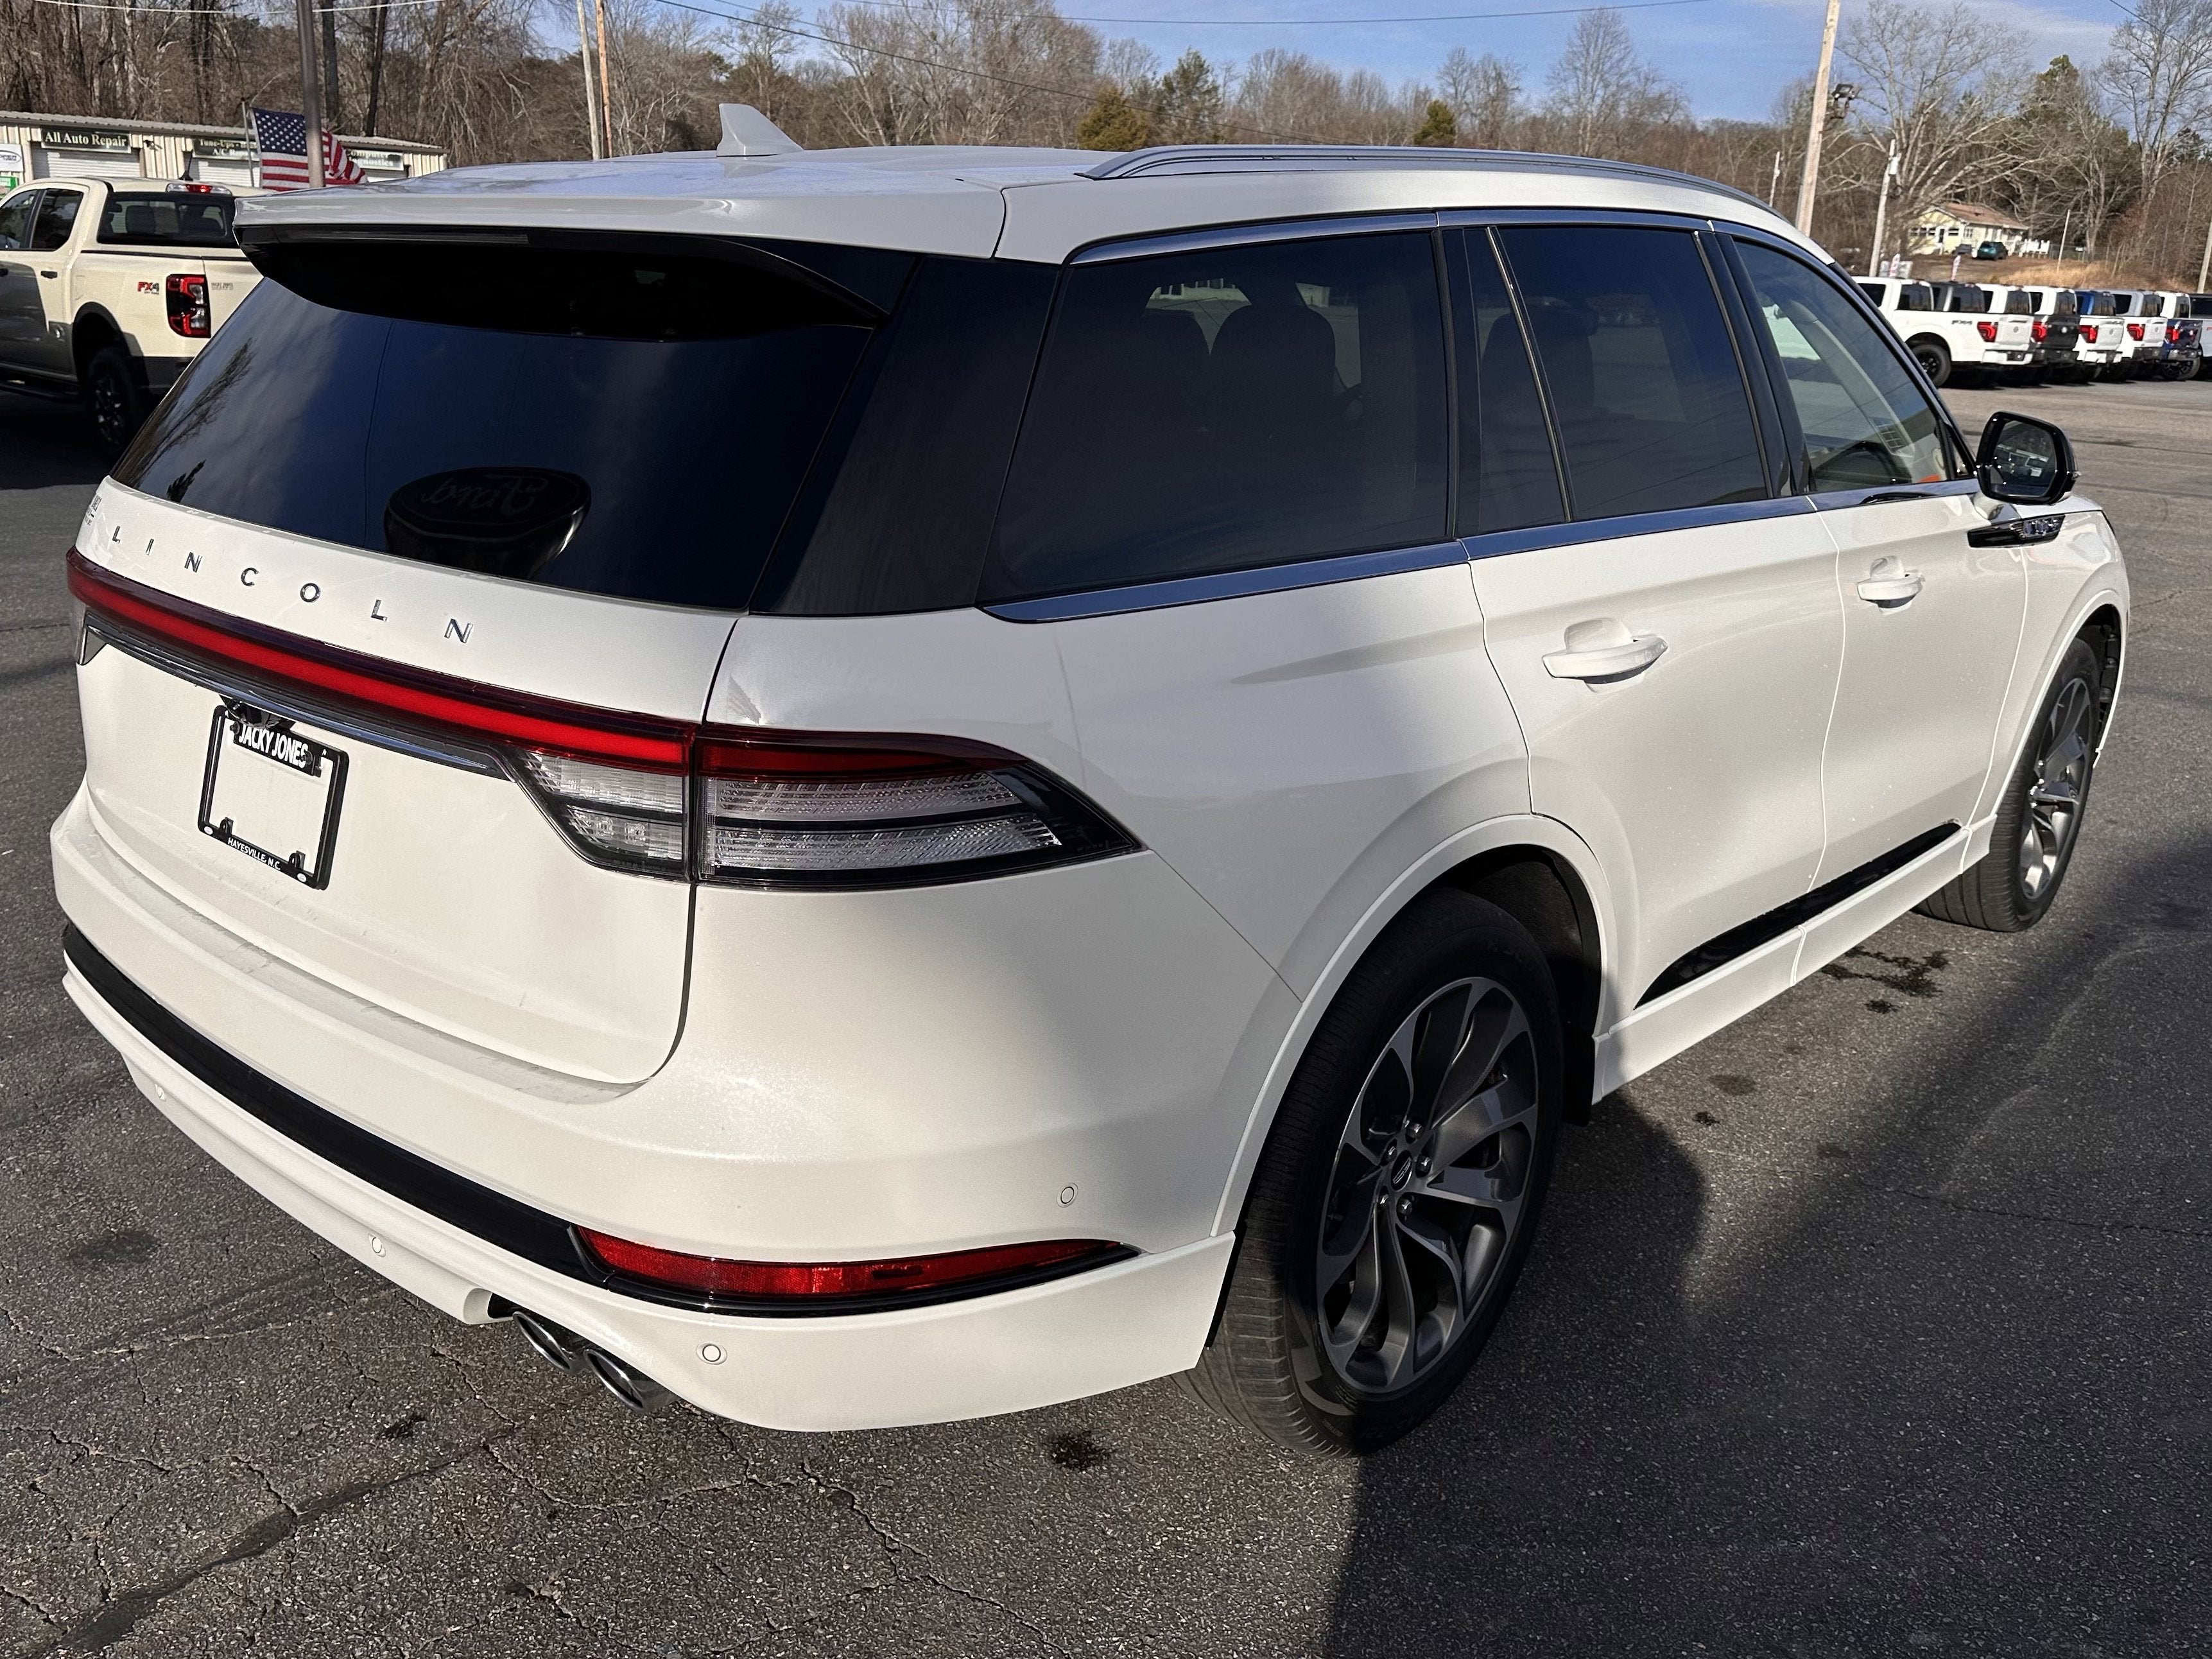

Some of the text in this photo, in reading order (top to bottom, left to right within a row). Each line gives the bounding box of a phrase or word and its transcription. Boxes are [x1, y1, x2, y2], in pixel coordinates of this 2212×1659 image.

[45, 132, 127, 149] All Auto Repair
[137, 281, 160, 292] FX4
[112, 525, 473, 643] LINCOLN
[238, 724, 309, 769] JACKY JONES
